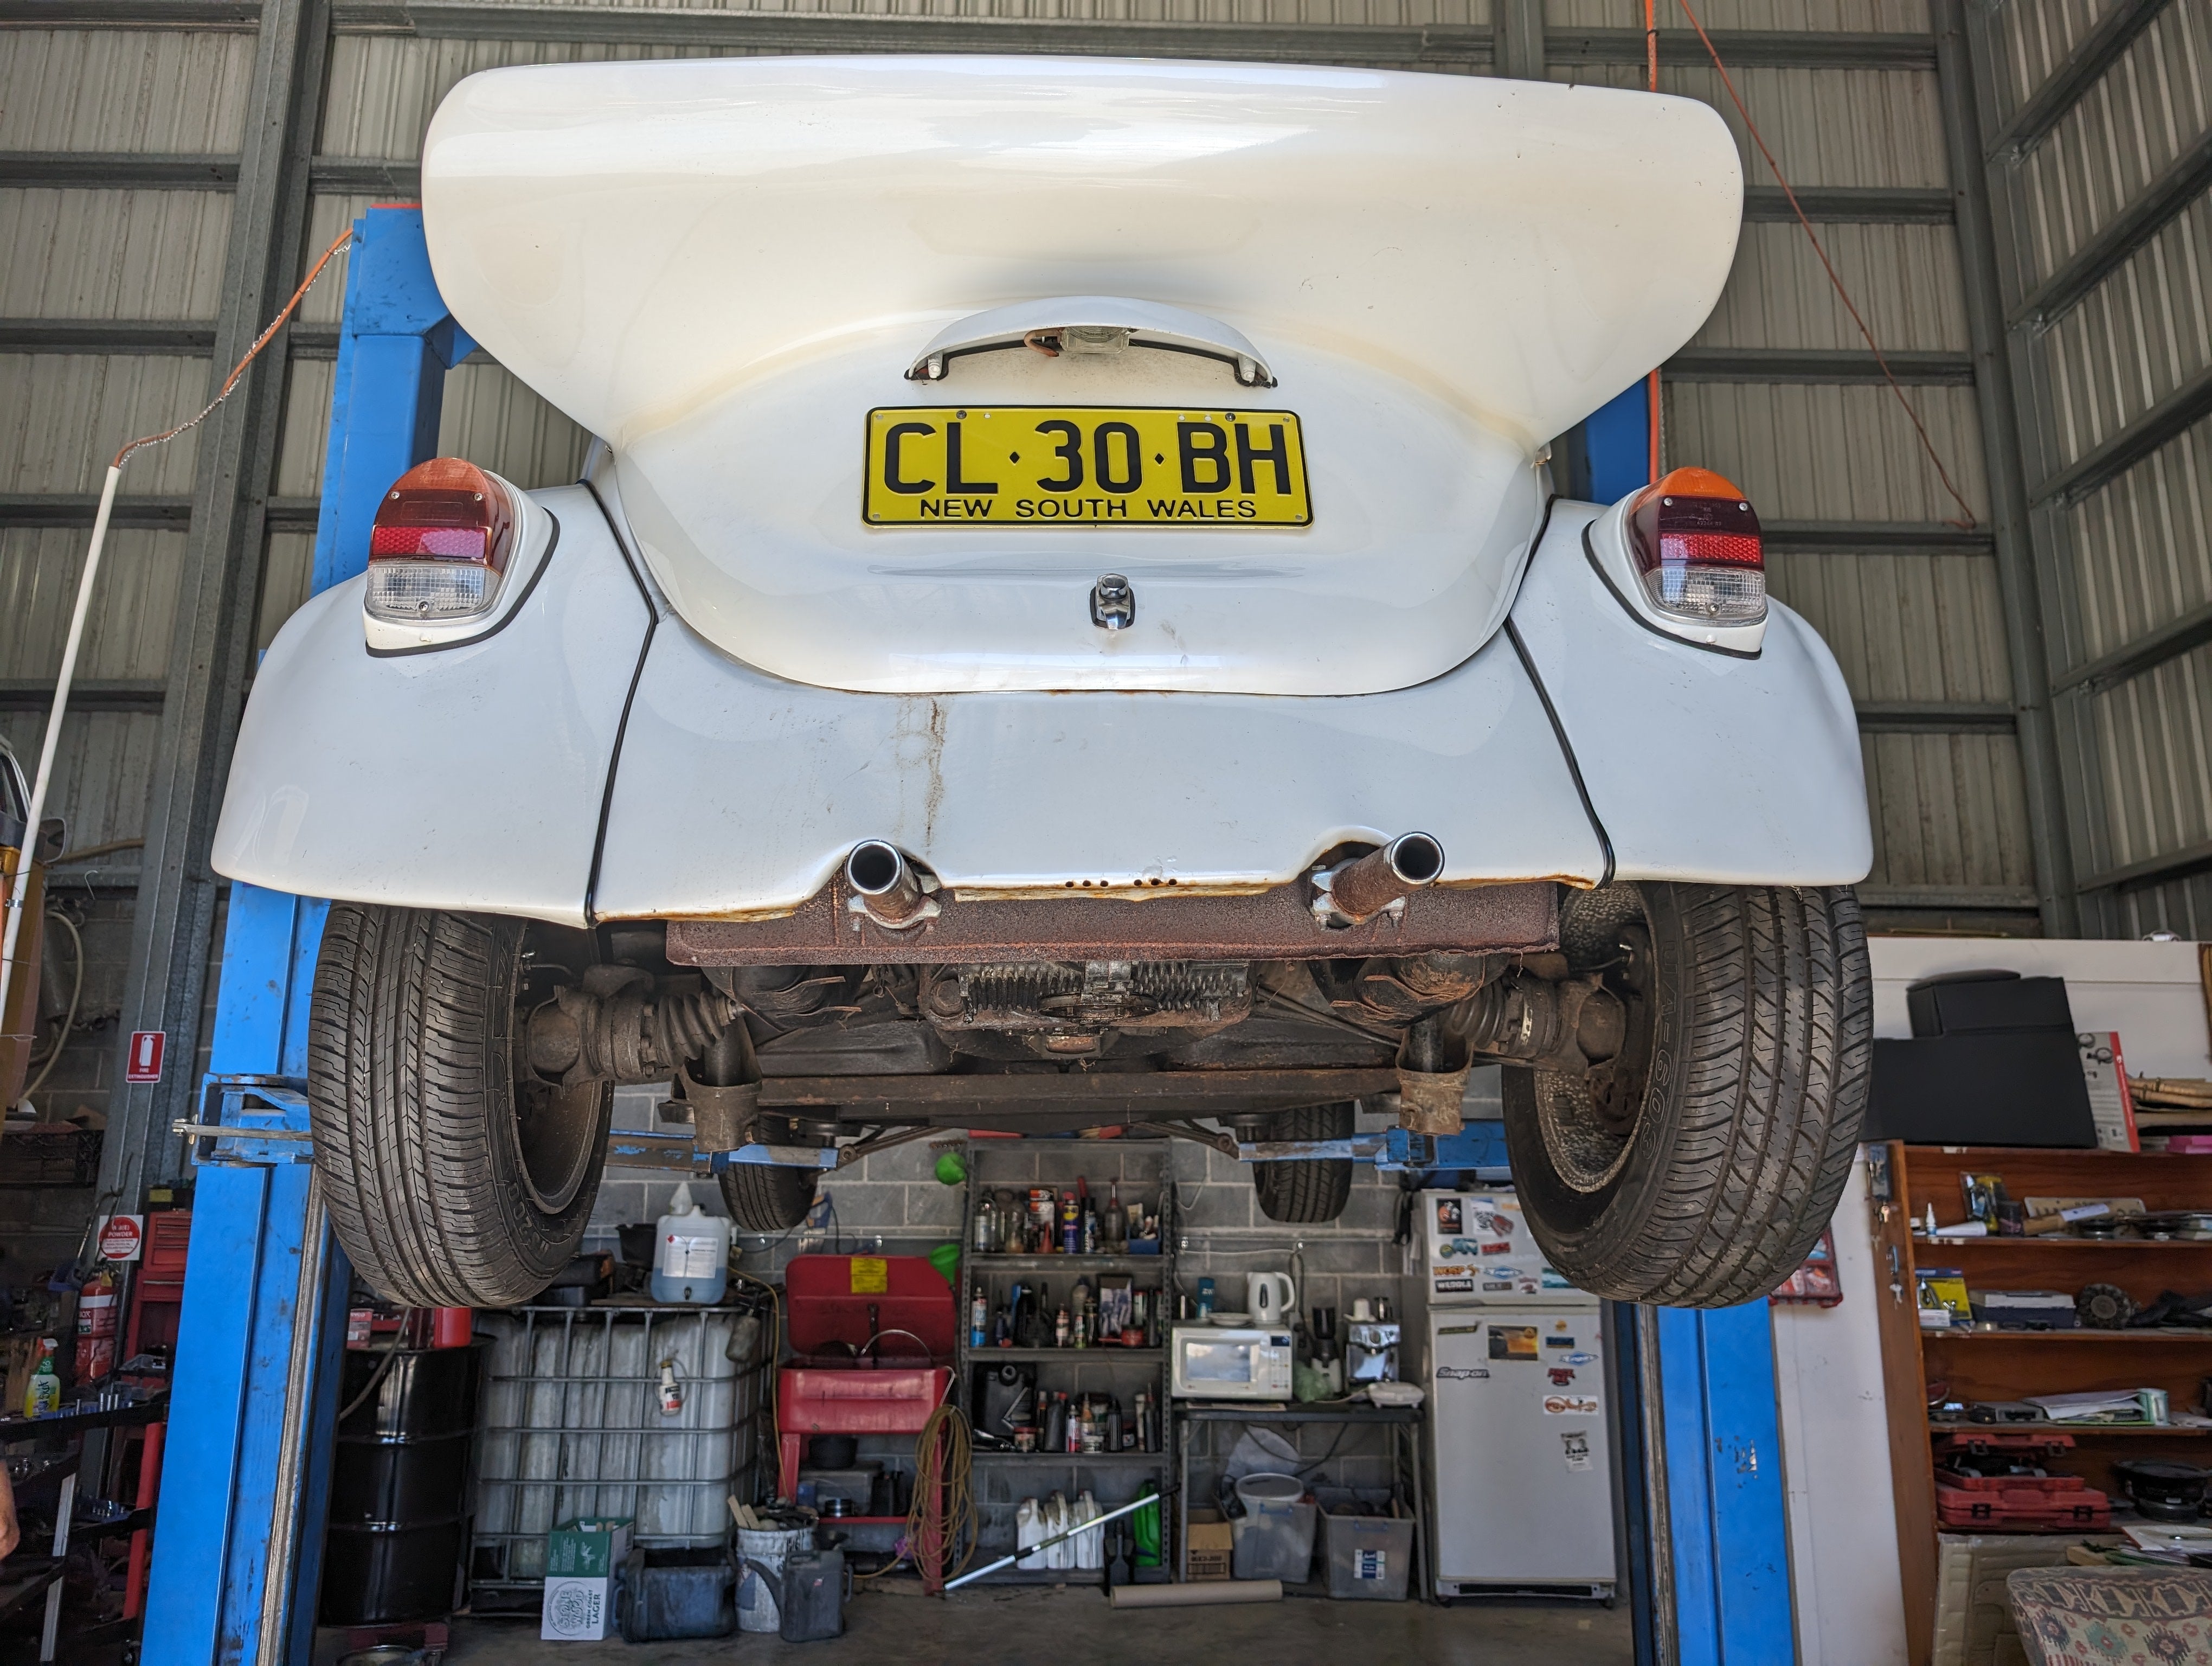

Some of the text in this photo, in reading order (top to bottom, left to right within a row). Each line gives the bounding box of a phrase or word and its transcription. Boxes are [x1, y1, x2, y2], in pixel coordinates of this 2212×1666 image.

[920, 499, 1257, 518] NEW SOUTH WALES
[1437, 1367, 1489, 1379] Snap-on
[592, 1594, 601, 1624] LAGER
